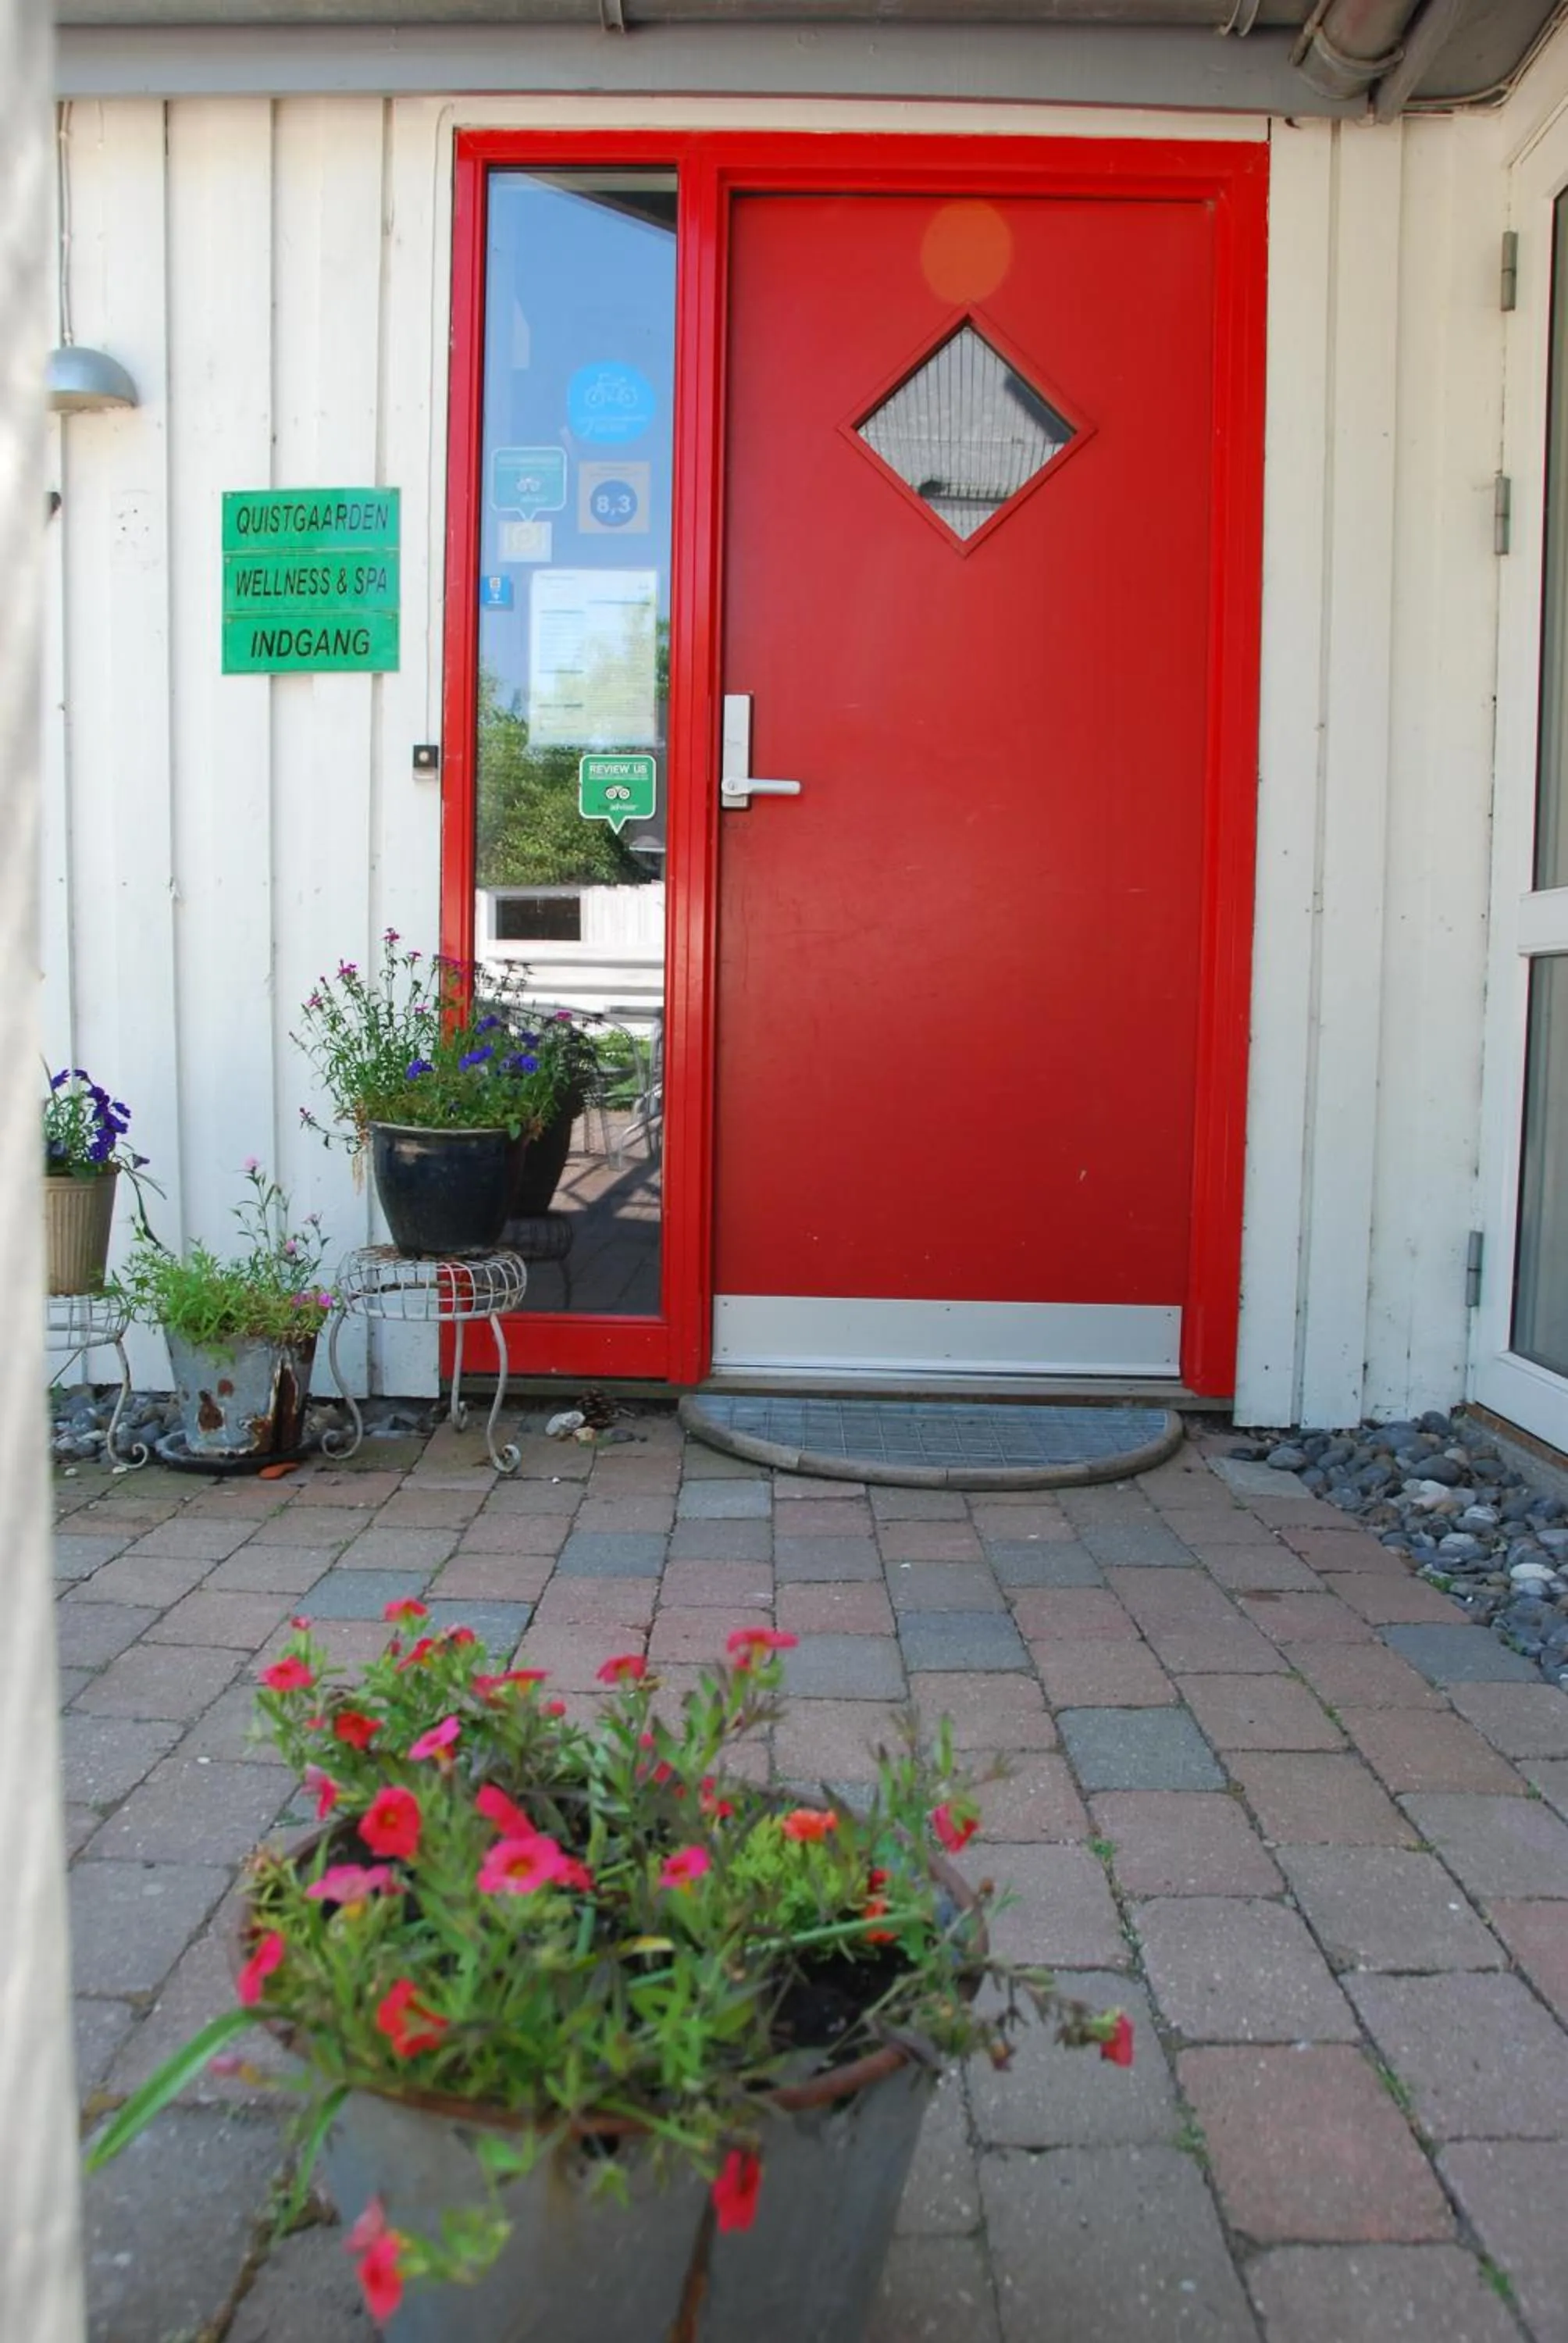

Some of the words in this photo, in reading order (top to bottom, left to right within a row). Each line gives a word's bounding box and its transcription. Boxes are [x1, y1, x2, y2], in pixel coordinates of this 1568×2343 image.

[236, 504, 389, 537] QUISTGAARDEN
[236, 568, 330, 597] WELLNESS
[337, 568, 347, 595] &
[354, 567, 387, 594] SPA
[251, 628, 370, 658] INDGANG
[590, 765, 629, 775] REVIEW
[633, 765, 647, 774] US
